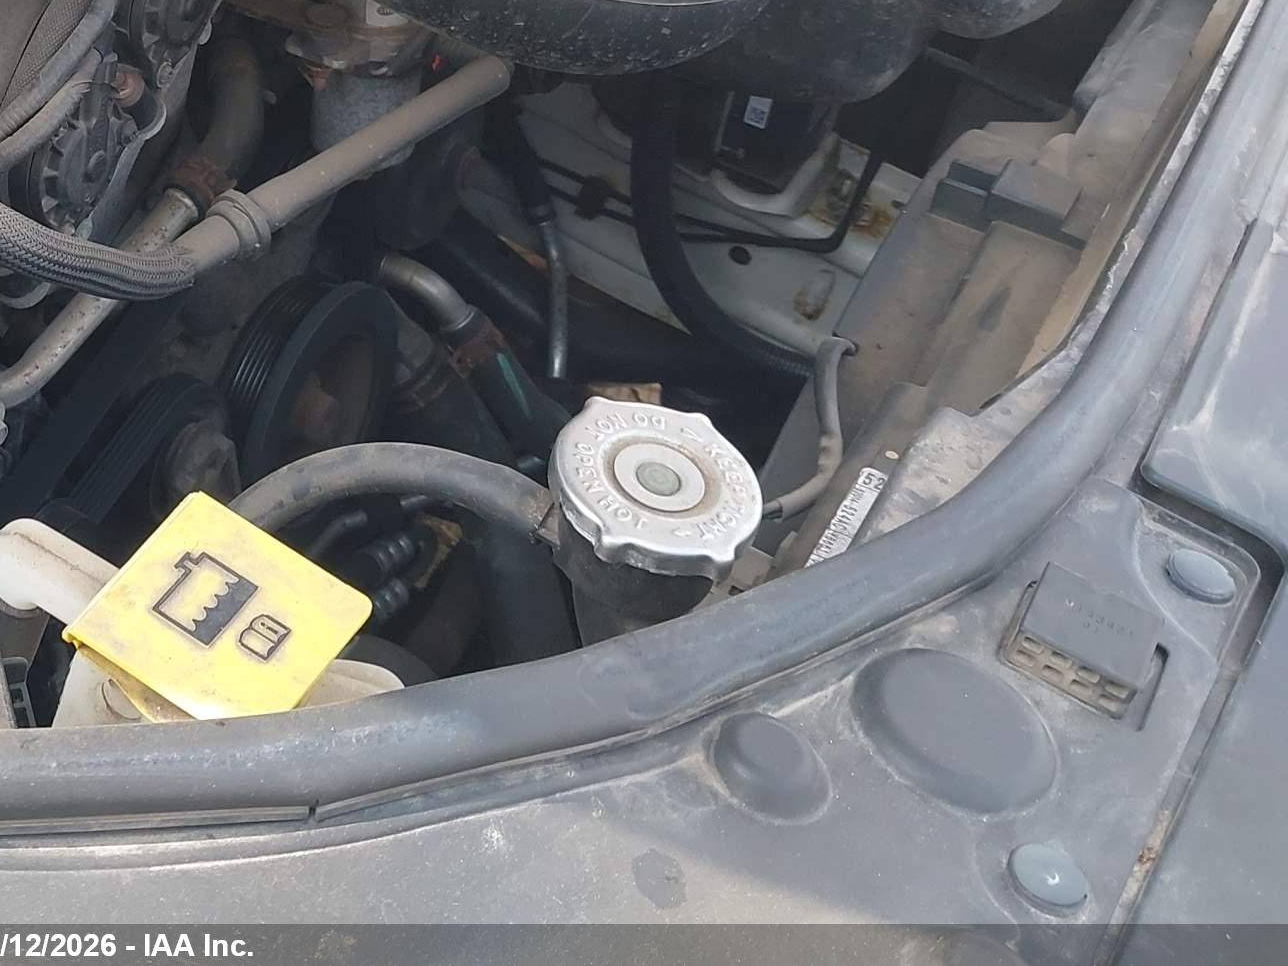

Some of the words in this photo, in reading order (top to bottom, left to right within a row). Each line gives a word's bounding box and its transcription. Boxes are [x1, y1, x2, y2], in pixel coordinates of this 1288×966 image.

[585, 411, 629, 442] NOT
[631, 412, 666, 430] DO
[862, 472, 886, 490] 52
